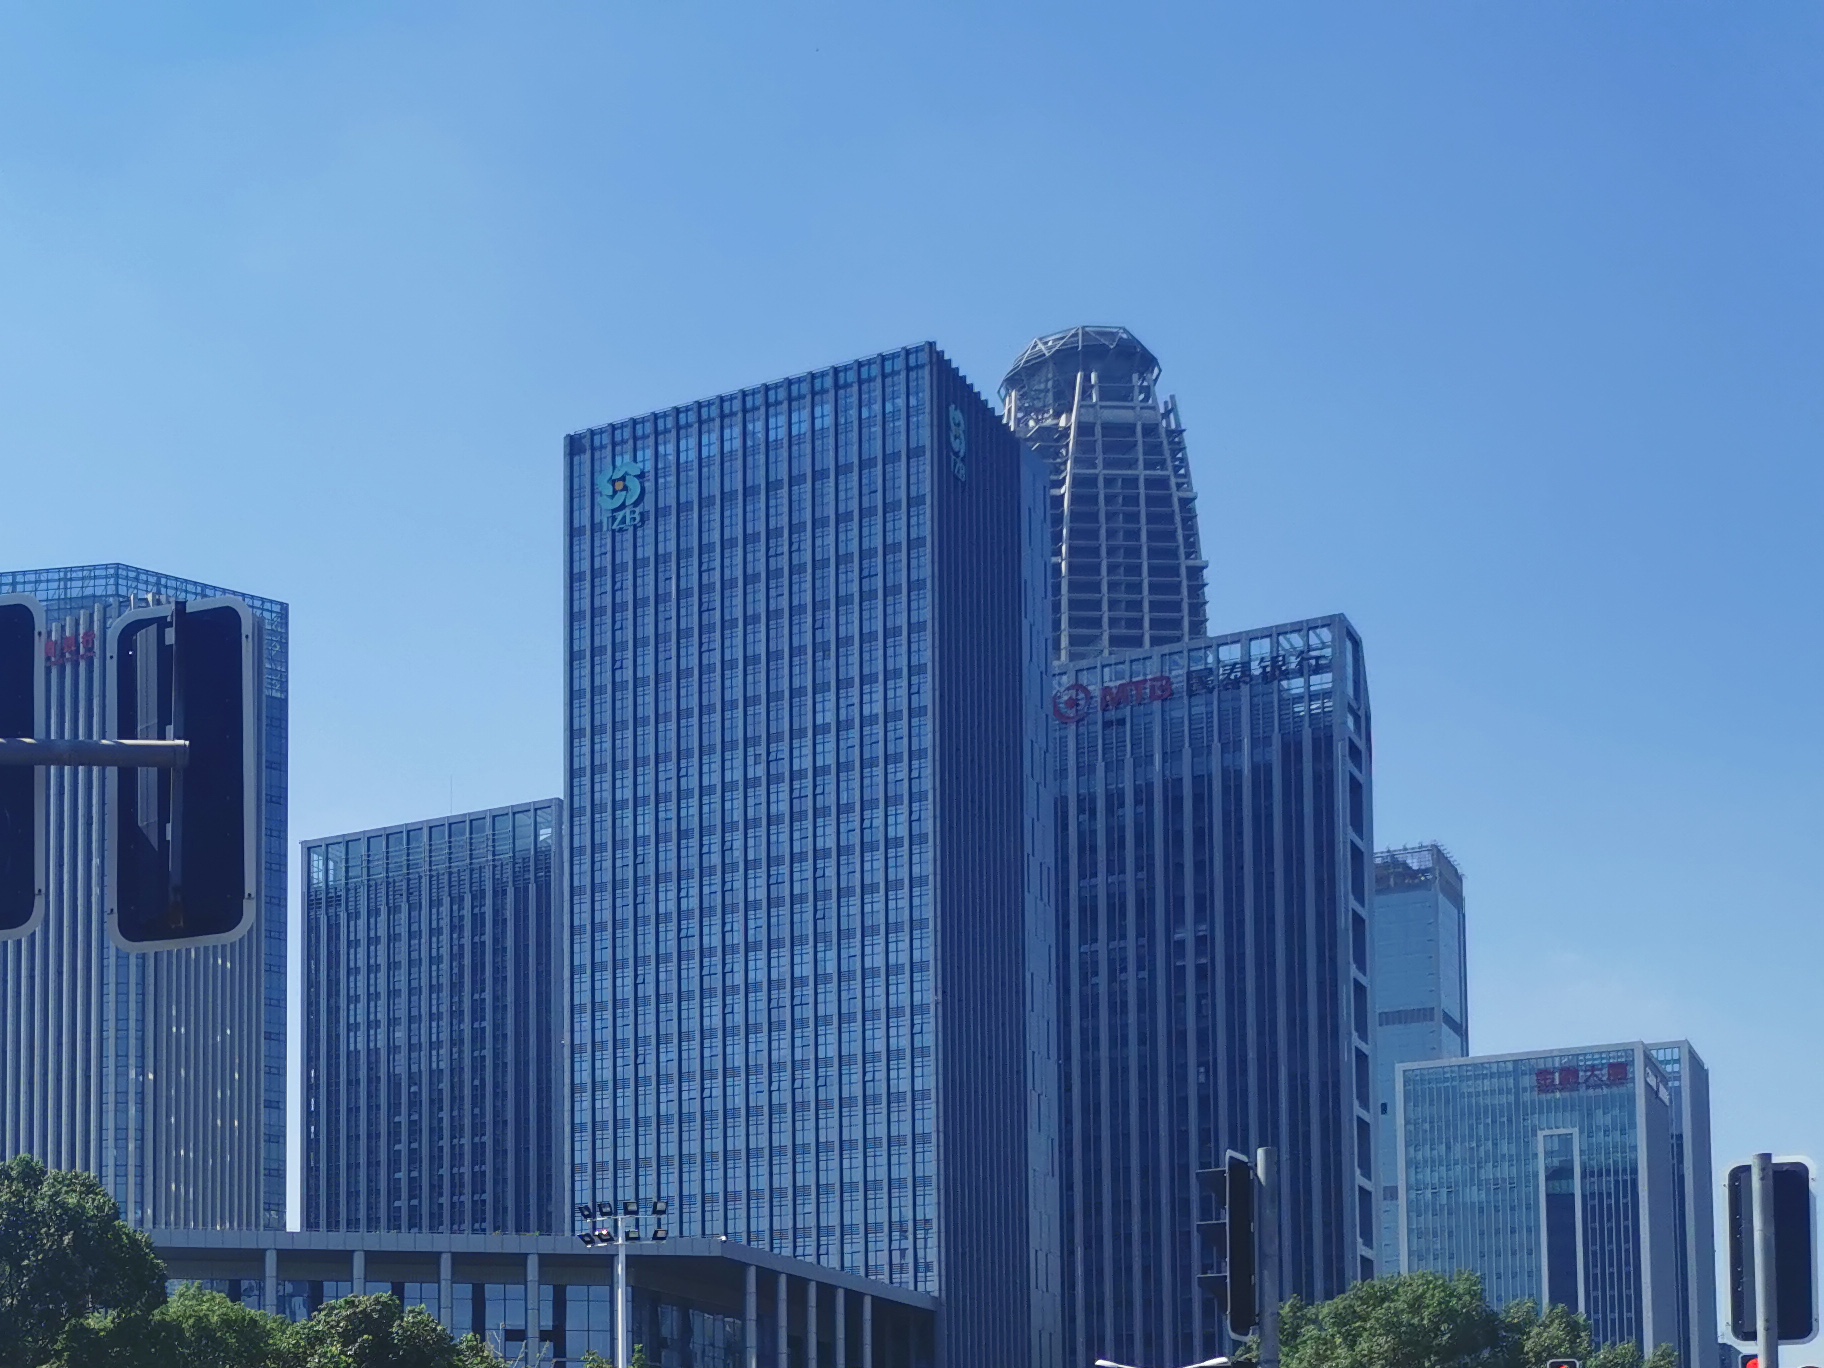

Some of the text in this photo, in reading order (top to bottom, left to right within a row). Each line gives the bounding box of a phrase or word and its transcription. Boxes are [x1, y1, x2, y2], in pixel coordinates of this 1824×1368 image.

[602, 507, 641, 531] TZB
[1100, 650, 1333, 711] MTB 民泰银行
